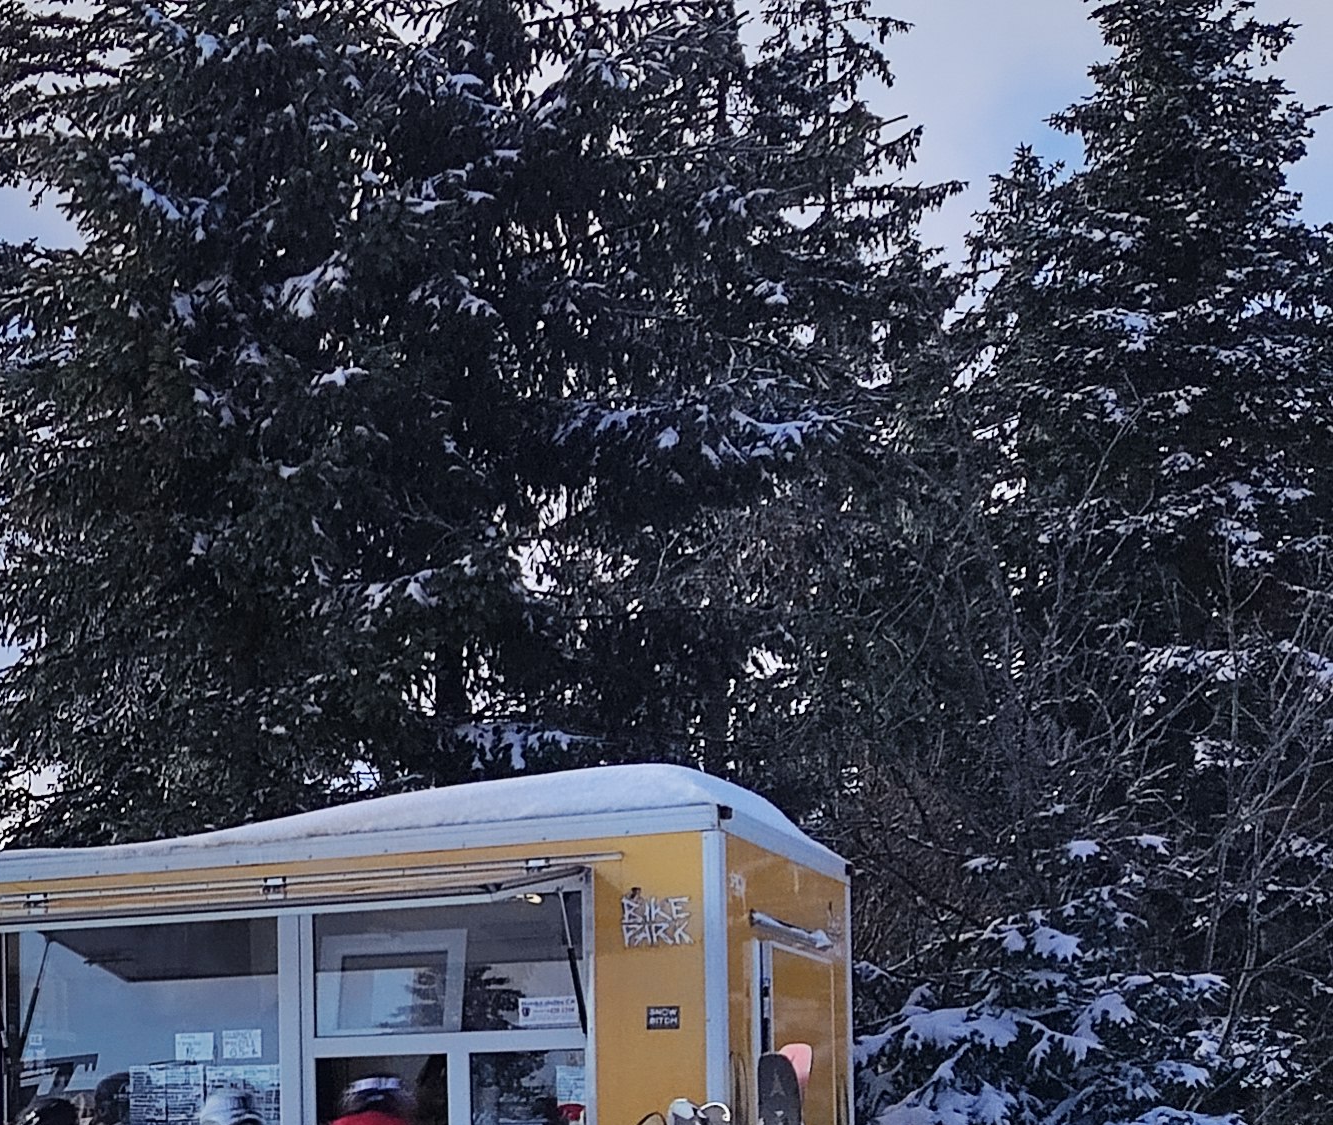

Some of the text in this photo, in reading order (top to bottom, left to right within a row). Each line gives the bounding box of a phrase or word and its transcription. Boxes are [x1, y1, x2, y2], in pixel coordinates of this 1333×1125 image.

[621, 896, 690, 923] BIKE
[622, 921, 693, 948] PARK
[649, 1008, 678, 1016] SNOW
